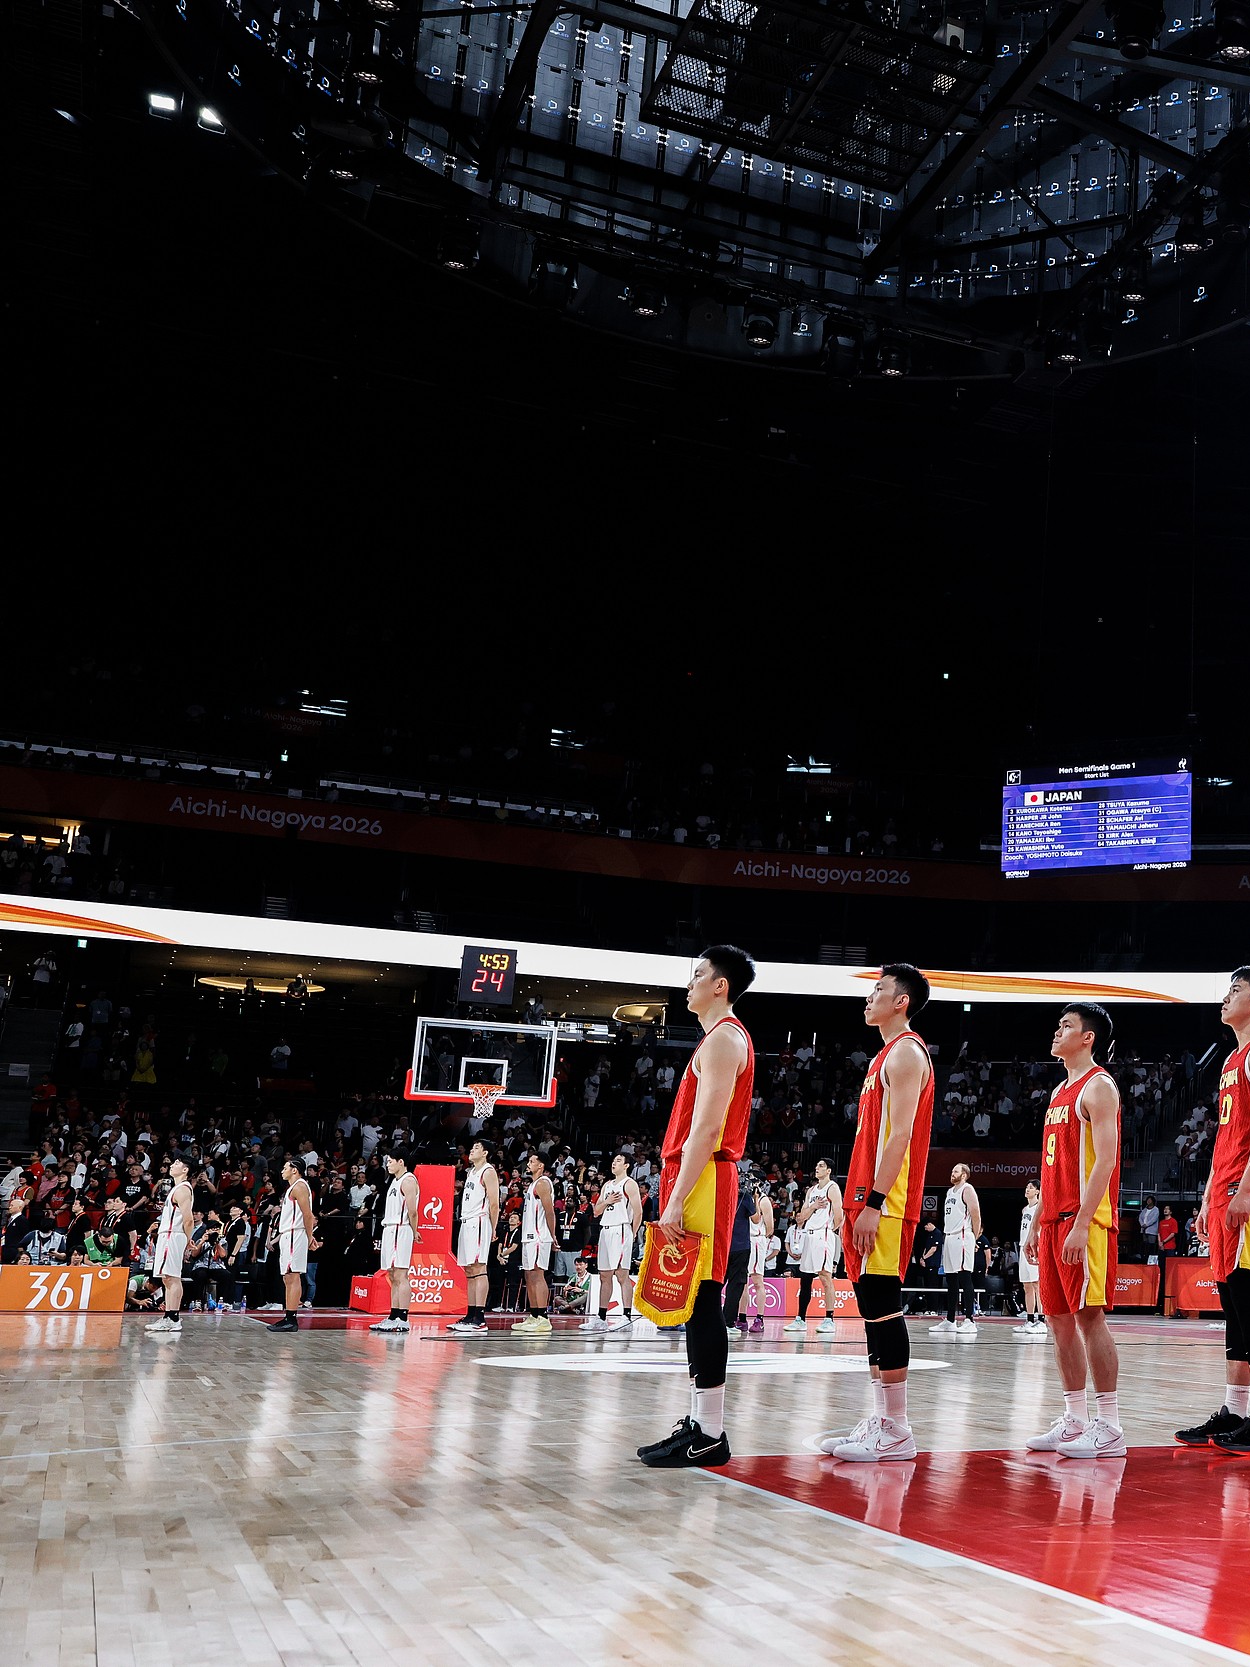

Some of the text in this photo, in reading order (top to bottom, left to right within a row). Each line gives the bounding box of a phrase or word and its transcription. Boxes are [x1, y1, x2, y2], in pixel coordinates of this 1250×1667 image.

[1074, 764, 1109, 773] Semifinals
[1110, 763, 1130, 771] Game
[1045, 791, 1082, 803] JAPAN
[169, 795, 382, 836] Aichi-Nagoya 2026
[733, 860, 910, 885] Aichi-Nagoya 2026
[480, 954, 510, 970] 4:53
[472, 970, 505, 992] 24
[1045, 1105, 1070, 1126] CHINA
[1046, 1133, 1056, 1166] 9
[971, 1162, 1037, 1176] ichi-Nagoya
[408, 1265, 448, 1276] Aichi-
[24, 1268, 112, 1309] 361°
[408, 1278, 454, 1291] agoya
[652, 1278, 683, 1291] TEAM CHINA
[653, 1285, 678, 1296] BASKETBALL
[410, 1292, 442, 1303] 2026
